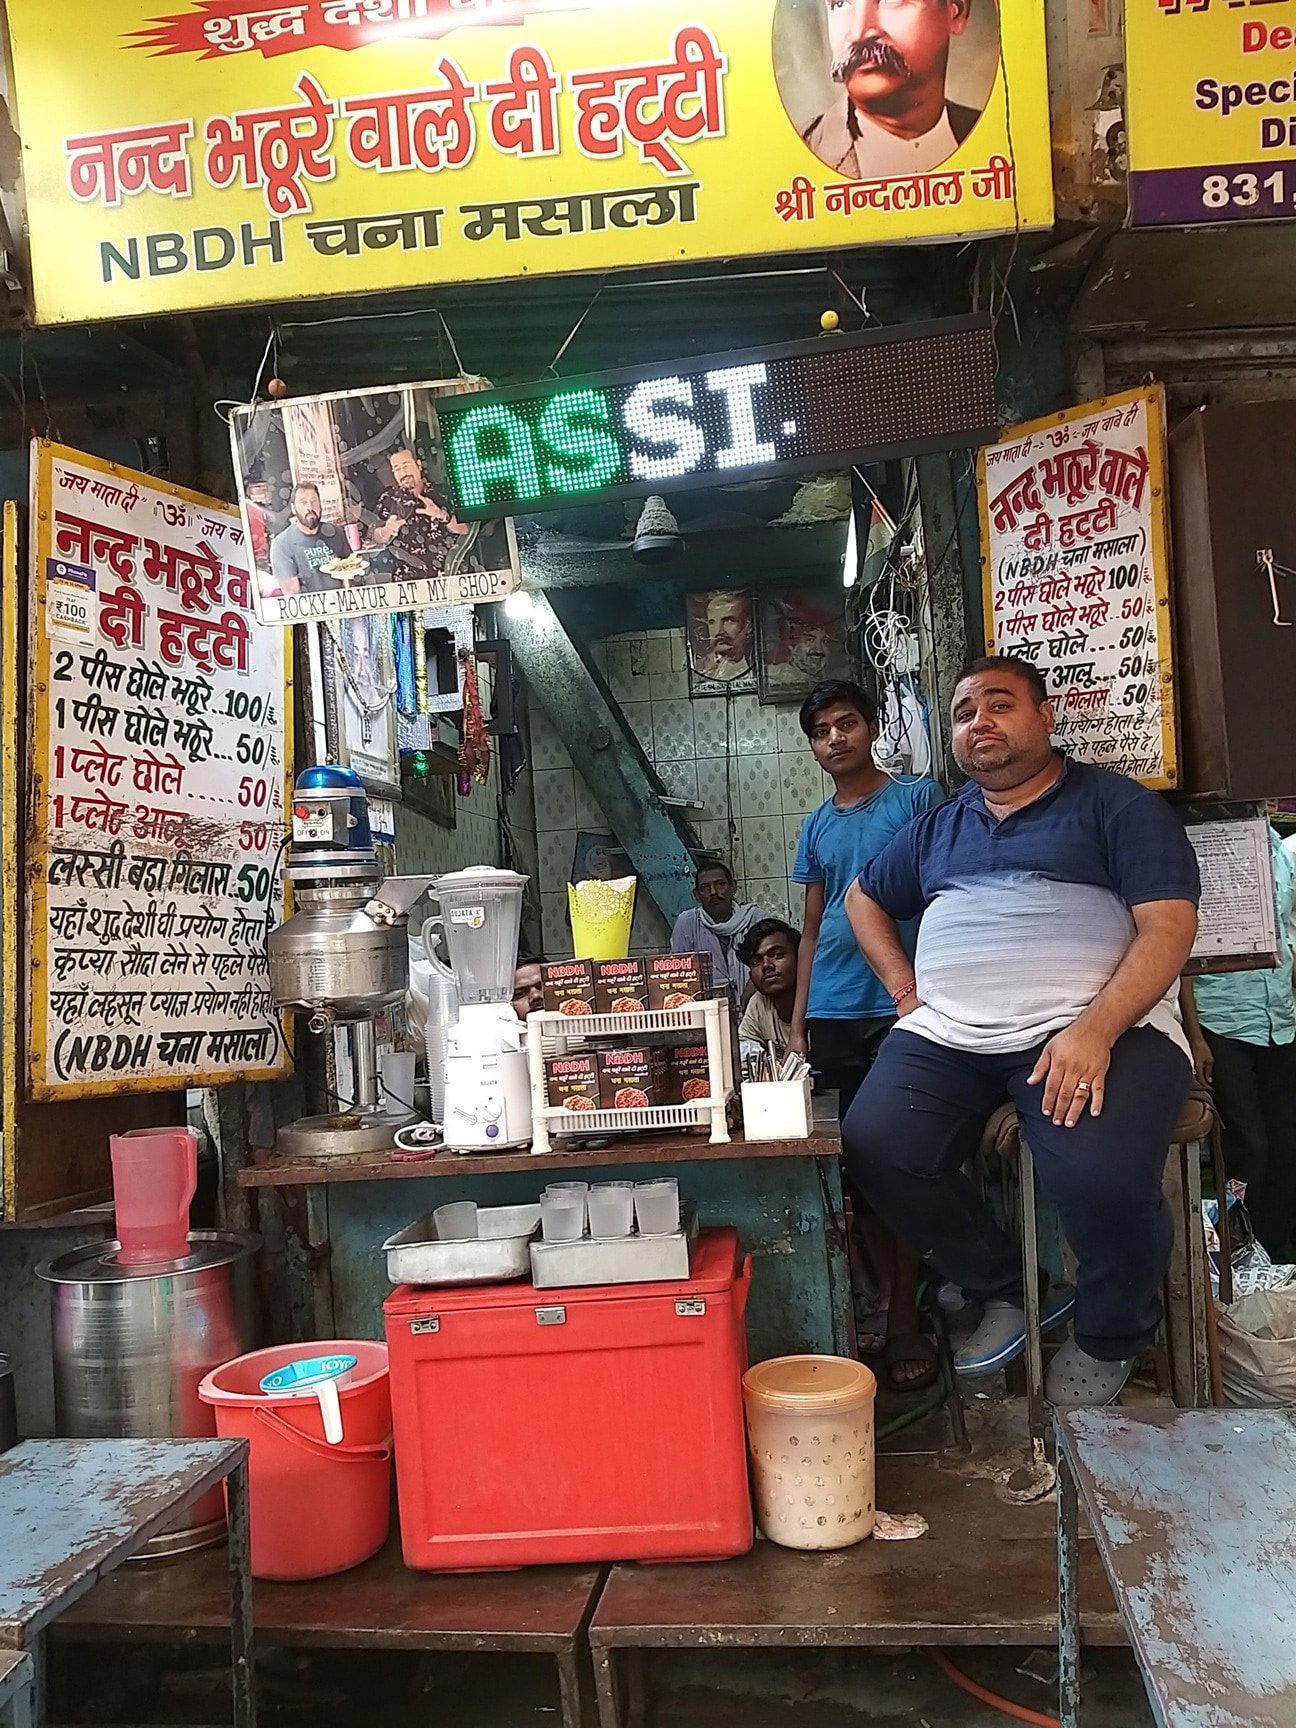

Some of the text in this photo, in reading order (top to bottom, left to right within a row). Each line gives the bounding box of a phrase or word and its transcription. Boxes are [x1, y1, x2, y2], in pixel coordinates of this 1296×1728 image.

[1243, 22, 1296, 52] De
[66, 27, 729, 214] नन्द भठूरे वाले दी हट्टी
[774, 154, 1014, 221] श्री नन्दलाल जी
[1202, 170, 1296, 208] 831
[100, 182, 700, 284] NBDH चना मसाला
[987, 453, 1001, 466] जय
[1020, 435, 1032, 457] दी
[1123, 401, 1139, 426] दी
[90, 481, 123, 507] माता
[989, 439, 1149, 532] नन्द भठूरे वाले
[1022, 498, 1117, 550] दी हट्टी
[55, 510, 139, 583] नन्द
[144, 540, 222, 611] भठूरे
[1061, 546, 1092, 567] चना
[56, 600, 86, 618] ₹100
[279, 587, 390, 619] ROCKY-MAYUR
[398, 582, 418, 605] AT
[428, 580, 448, 601] MY
[995, 591, 1005, 611] 2
[1008, 581, 1037, 607] पीस
[1074, 566, 1106, 598] भठूरे
[99, 586, 249, 673] दी हट्टी
[998, 621, 1003, 639] 1
[1007, 610, 1038, 636] पीस
[1079, 597, 1110, 630] भठूरे
[53, 651, 74, 681] 2
[80, 648, 126, 692] पीस
[171, 675, 214, 716] भठूरे
[1052, 662, 1097, 688] आलू
[1064, 687, 1110, 712] गिलास
[56, 698, 65, 728] 1
[72, 693, 120, 737] पीस
[173, 718, 213, 763] भठूरे
[1078, 736, 1089, 756] से
[1092, 735, 1118, 757] पहले
[55, 746, 64, 779] 1
[71, 740, 127, 787] प्लेट
[53, 795, 63, 828] 1
[71, 788, 130, 835] प्लेट
[133, 804, 193, 849] आलू
[48, 839, 126, 889] लस्सी
[128, 855, 167, 898] बड़ा
[168, 850, 232, 897] गिलास
[50, 898, 88, 939] यहाँ
[122, 899, 157, 940] देशी
[157, 901, 177, 939] घी
[174, 904, 229, 939] प्रयोग
[229, 907, 264, 947] होता
[54, 947, 117, 981] कृप्या
[120, 942, 159, 977] सौदा
[160, 942, 192, 976] लेने
[192, 944, 209, 975] से
[212, 948, 245, 981] पहले
[548, 964, 585, 978] NBDH
[601, 962, 638, 976] NBDH
[654, 958, 691, 971] NBDH
[50, 983, 89, 1022] यहाँ
[88, 991, 147, 1026] लहसून
[150, 991, 192, 1017] प्याज
[191, 982, 231, 1016] प्रयोग
[157, 1031, 206, 1067] चना
[553, 1060, 590, 1074] NBDH
[606, 1052, 643, 1065] NBDH
